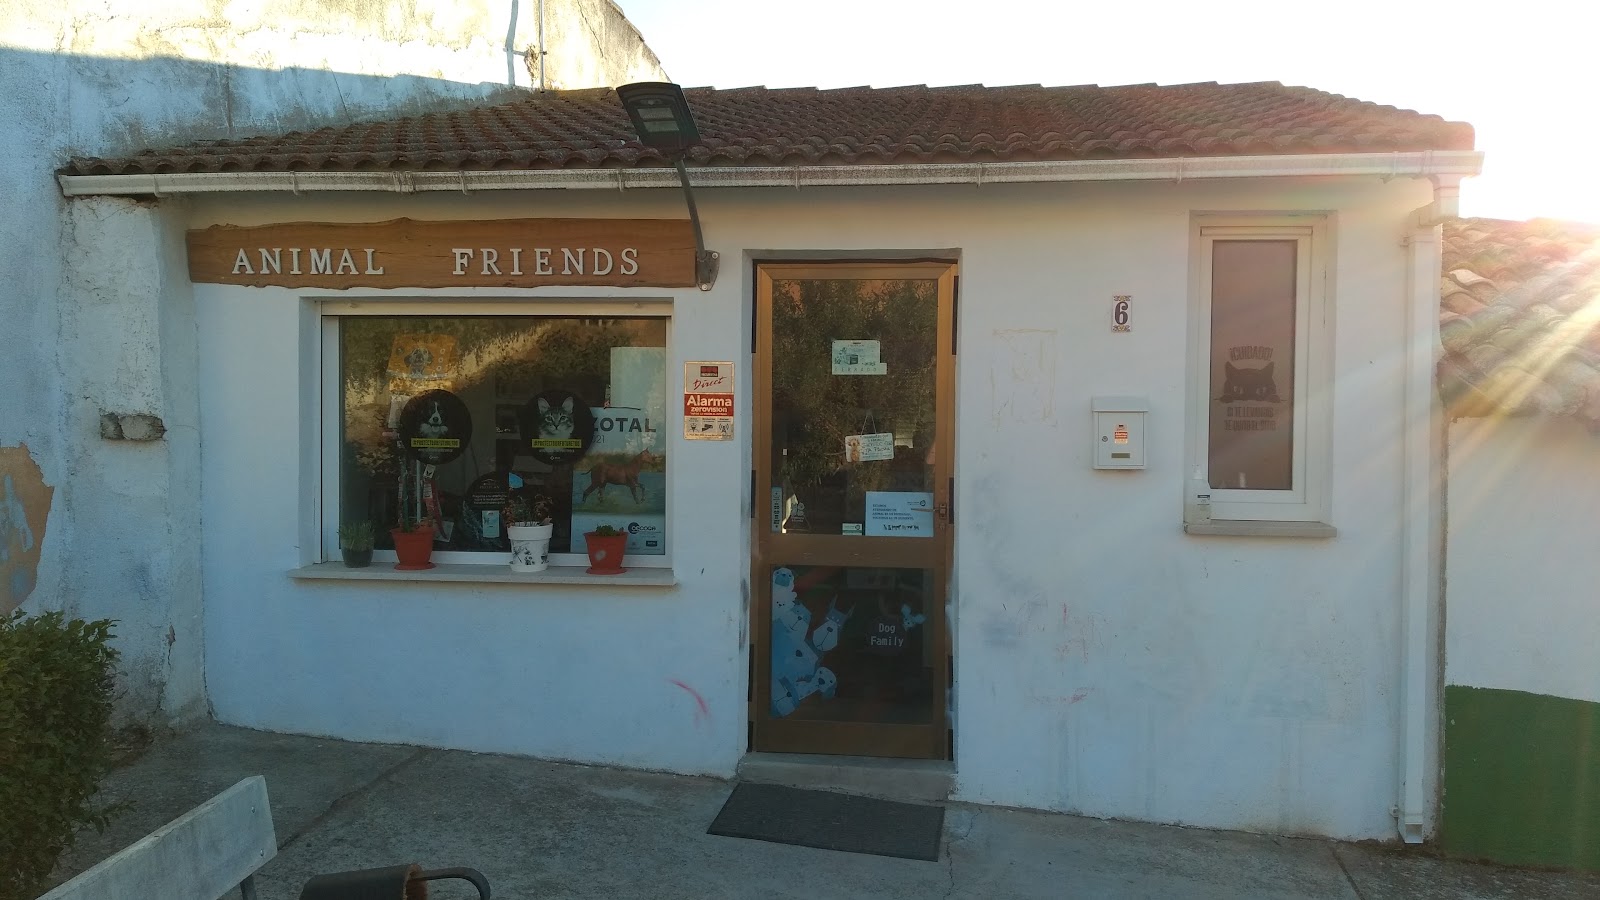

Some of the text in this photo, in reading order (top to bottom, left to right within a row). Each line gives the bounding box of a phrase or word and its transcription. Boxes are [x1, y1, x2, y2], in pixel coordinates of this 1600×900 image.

[232, 247, 639, 276] ANIMAL FRIENDS
[1115, 301, 1128, 325] 6
[693, 376, 727, 391] Direct
[687, 395, 732, 407] Alarma
[878, 622, 896, 634] Dog
[870, 635, 904, 647] Family
